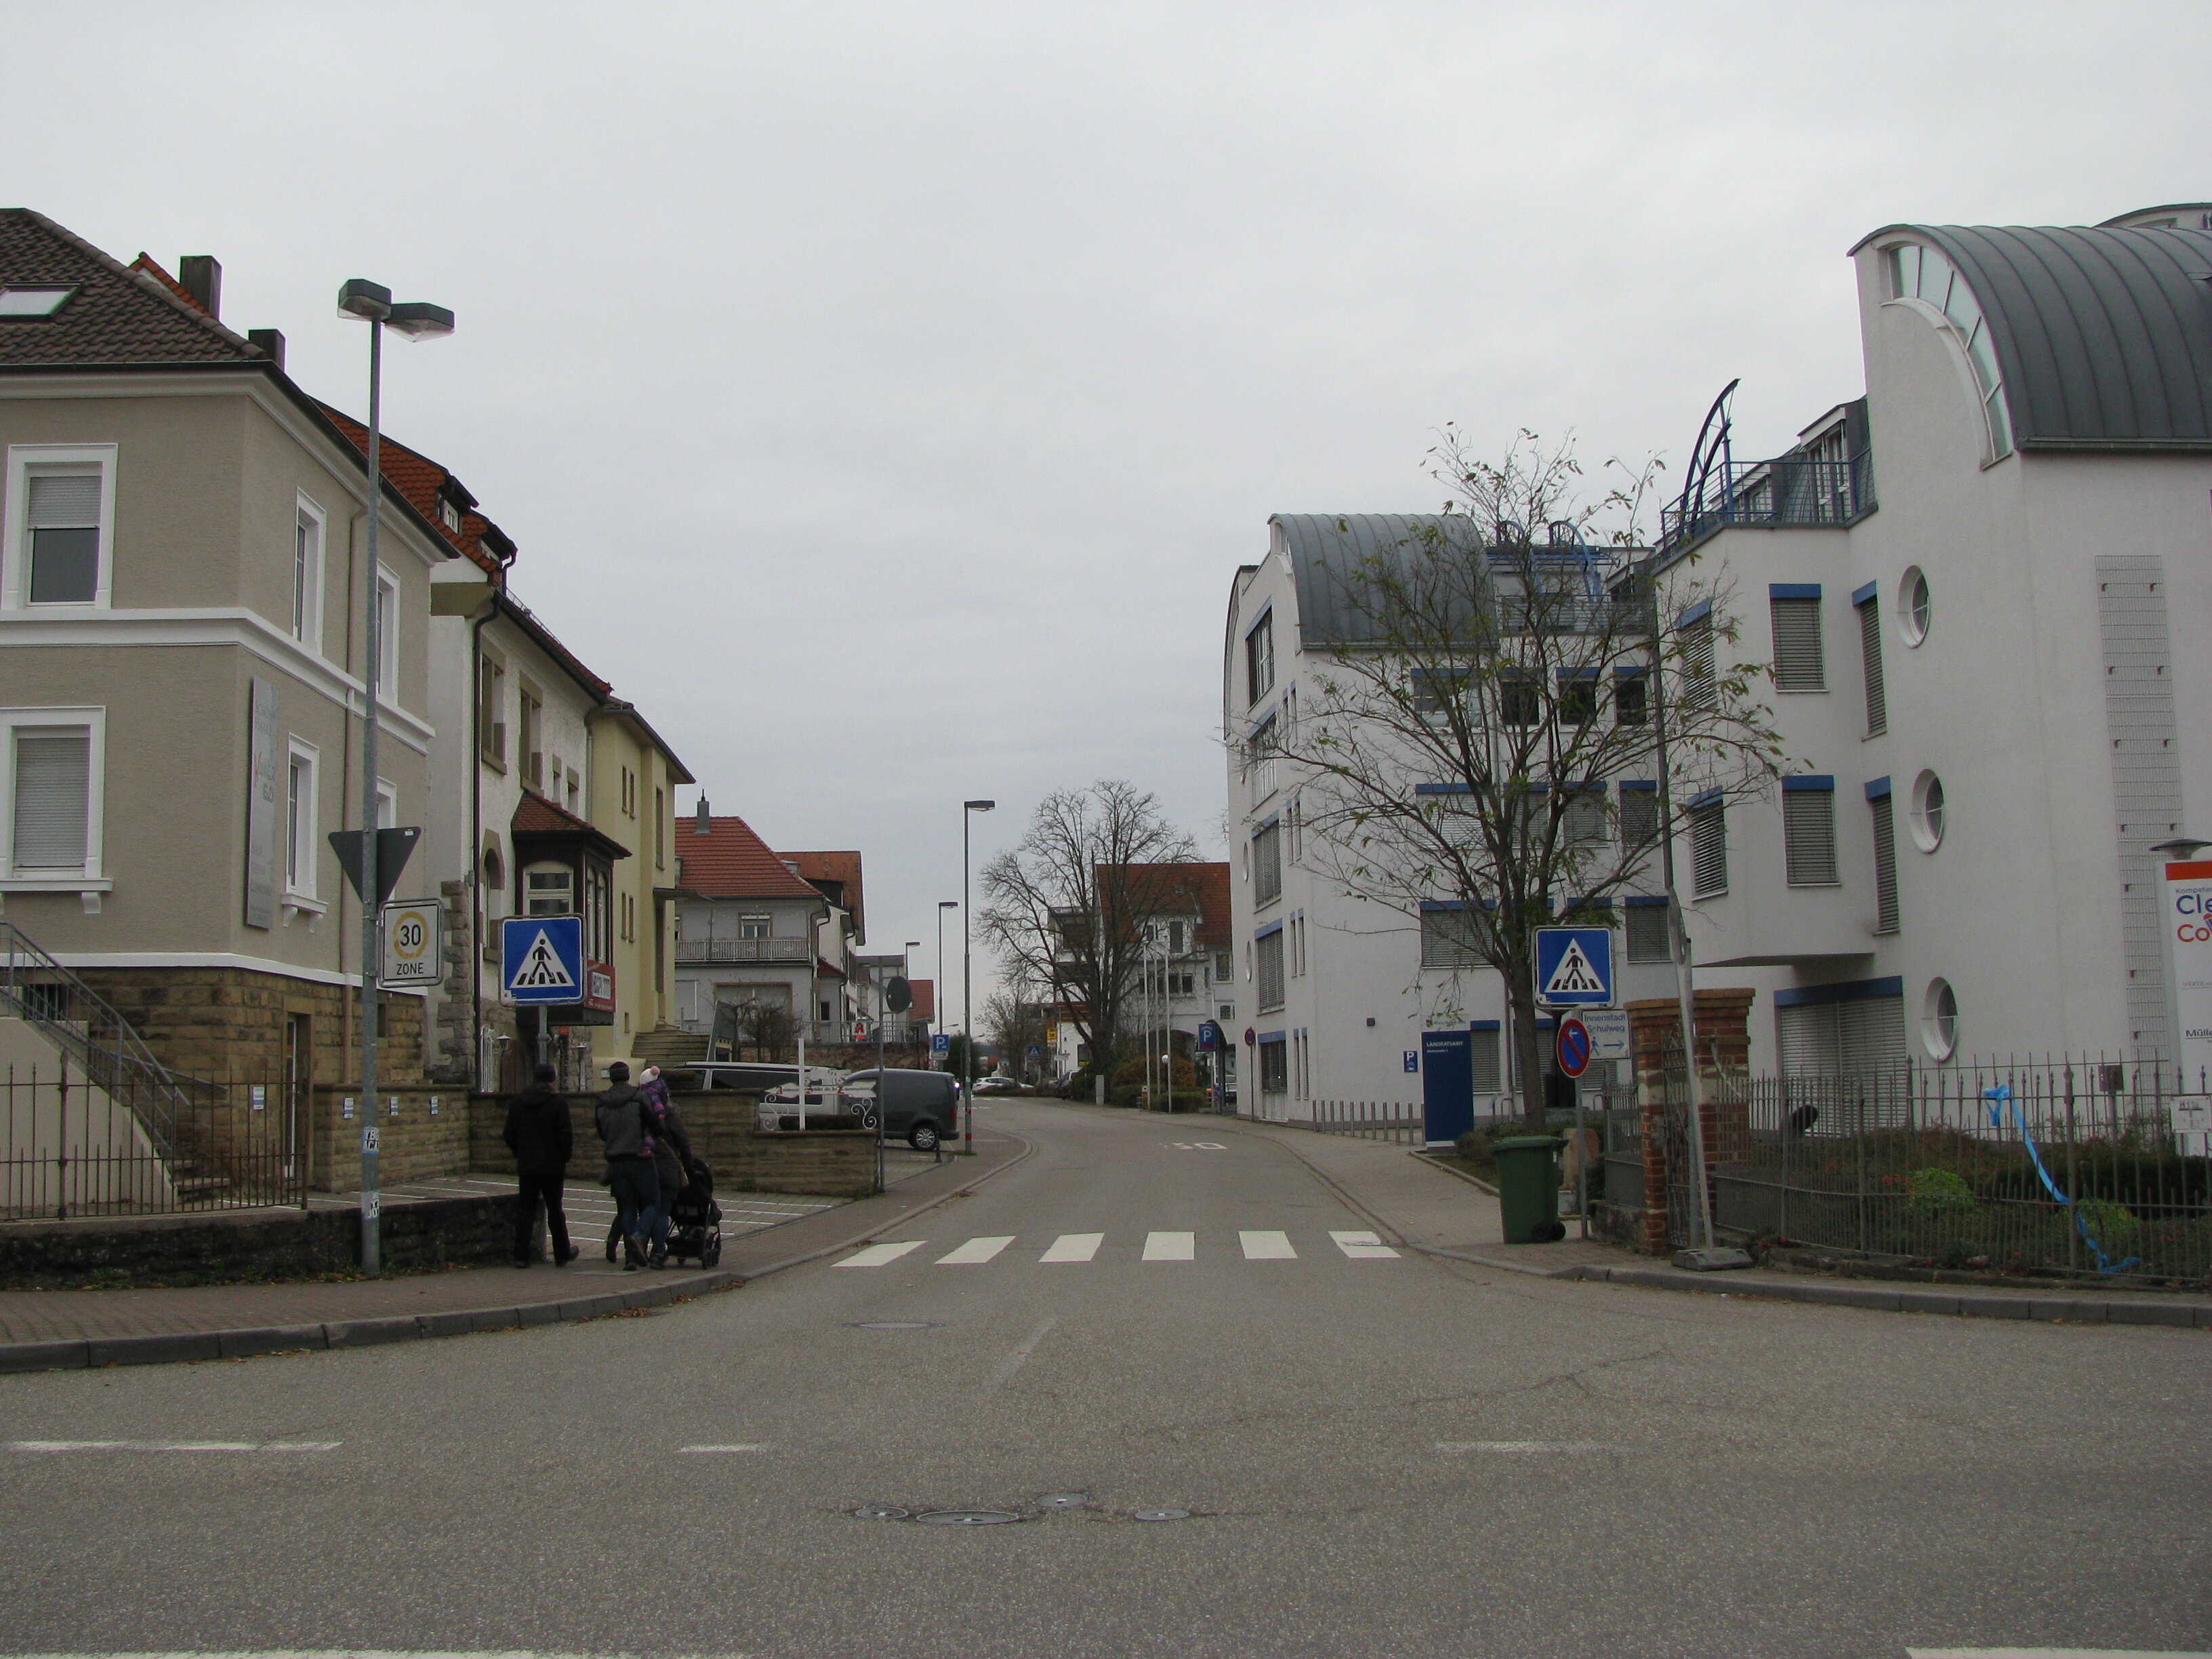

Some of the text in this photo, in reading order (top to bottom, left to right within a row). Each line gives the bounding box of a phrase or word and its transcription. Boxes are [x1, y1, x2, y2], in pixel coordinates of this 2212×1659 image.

[400, 924, 421, 946] 30
[396, 962, 424, 975] ZONE
[1584, 1013, 1626, 1021] Innenstadt
[1204, 1030, 1212, 1042] P
[937, 1037, 945, 1049] P
[1407, 1051, 1414, 1061] P
